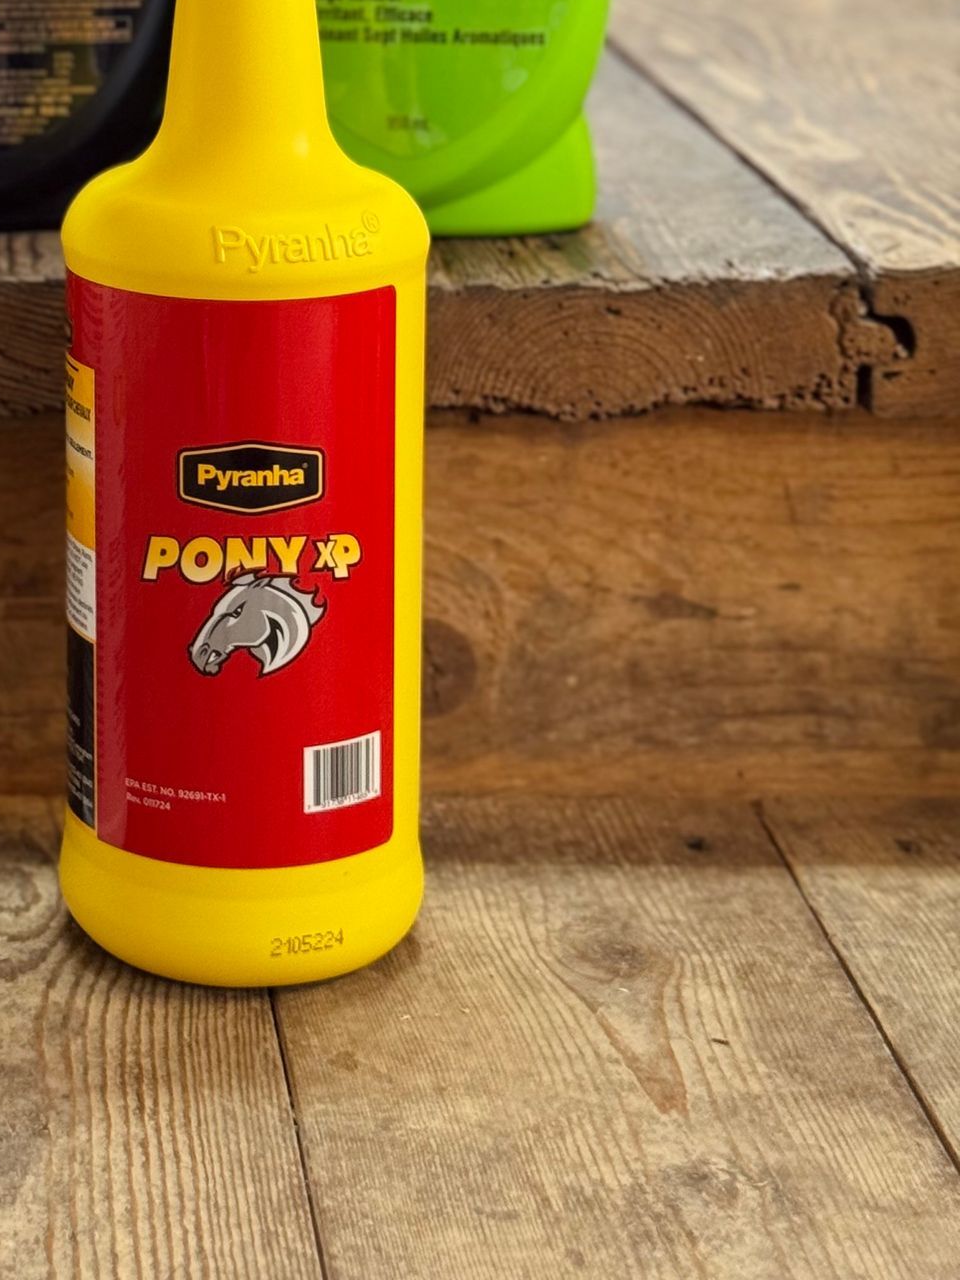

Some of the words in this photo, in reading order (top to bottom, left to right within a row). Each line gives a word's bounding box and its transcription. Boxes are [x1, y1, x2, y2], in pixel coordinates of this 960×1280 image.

[375, 7, 433, 24] Efficace
[453, 29, 547, 49] Aromatiques
[143, 535, 308, 582] PONY
[124, 777, 140, 788] EPA
[141, 782, 159, 793] EST.
[159, 786, 176, 798] NO.
[270, 927, 344, 957] 2105224
